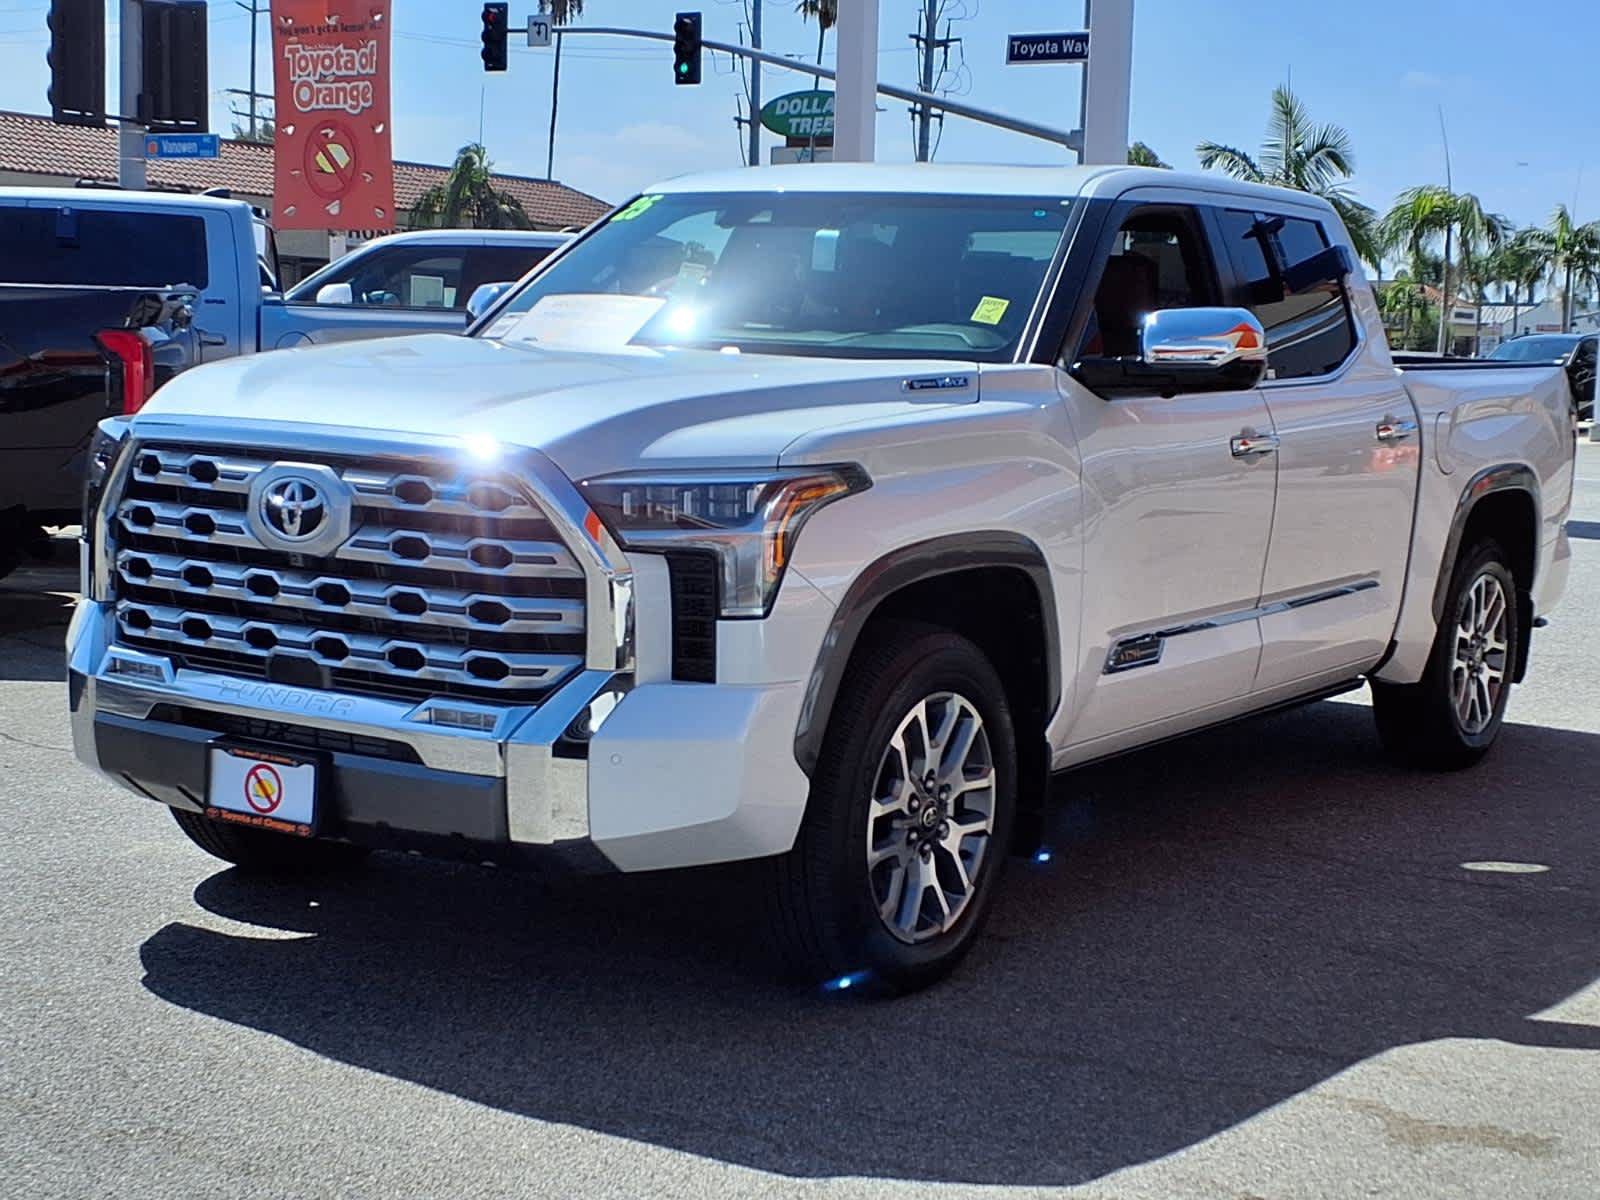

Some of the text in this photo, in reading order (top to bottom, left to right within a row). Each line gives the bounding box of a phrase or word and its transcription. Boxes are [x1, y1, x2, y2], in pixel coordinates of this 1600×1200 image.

[1012, 39, 1089, 57] Toyota Way
[284, 40, 376, 81] Toyota of
[293, 77, 373, 114] Orange
[775, 97, 835, 115] DOLLA
[788, 116, 834, 135] TREE
[161, 139, 198, 154] Vanowen
[219, 679, 357, 716] TUNDRA
[221, 809, 250, 823] Toyota
